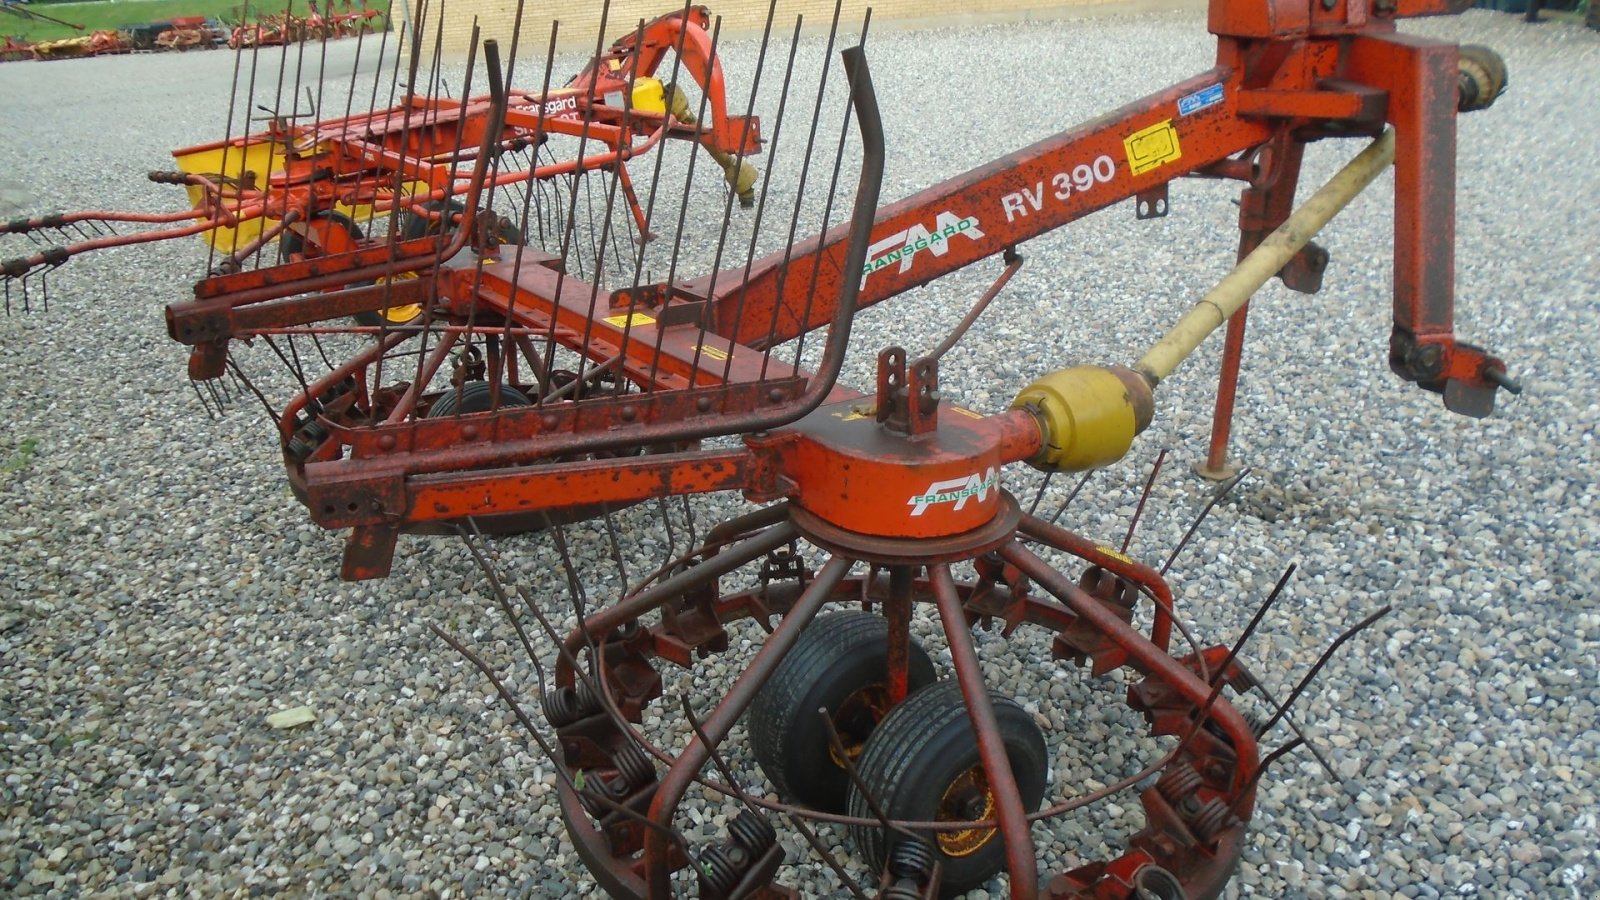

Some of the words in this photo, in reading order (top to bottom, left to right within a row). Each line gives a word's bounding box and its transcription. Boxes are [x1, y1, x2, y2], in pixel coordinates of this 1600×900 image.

[1001, 181, 1043, 222] RV
[1052, 155, 1115, 200] 390
[862, 219, 971, 275] RANSGARD
